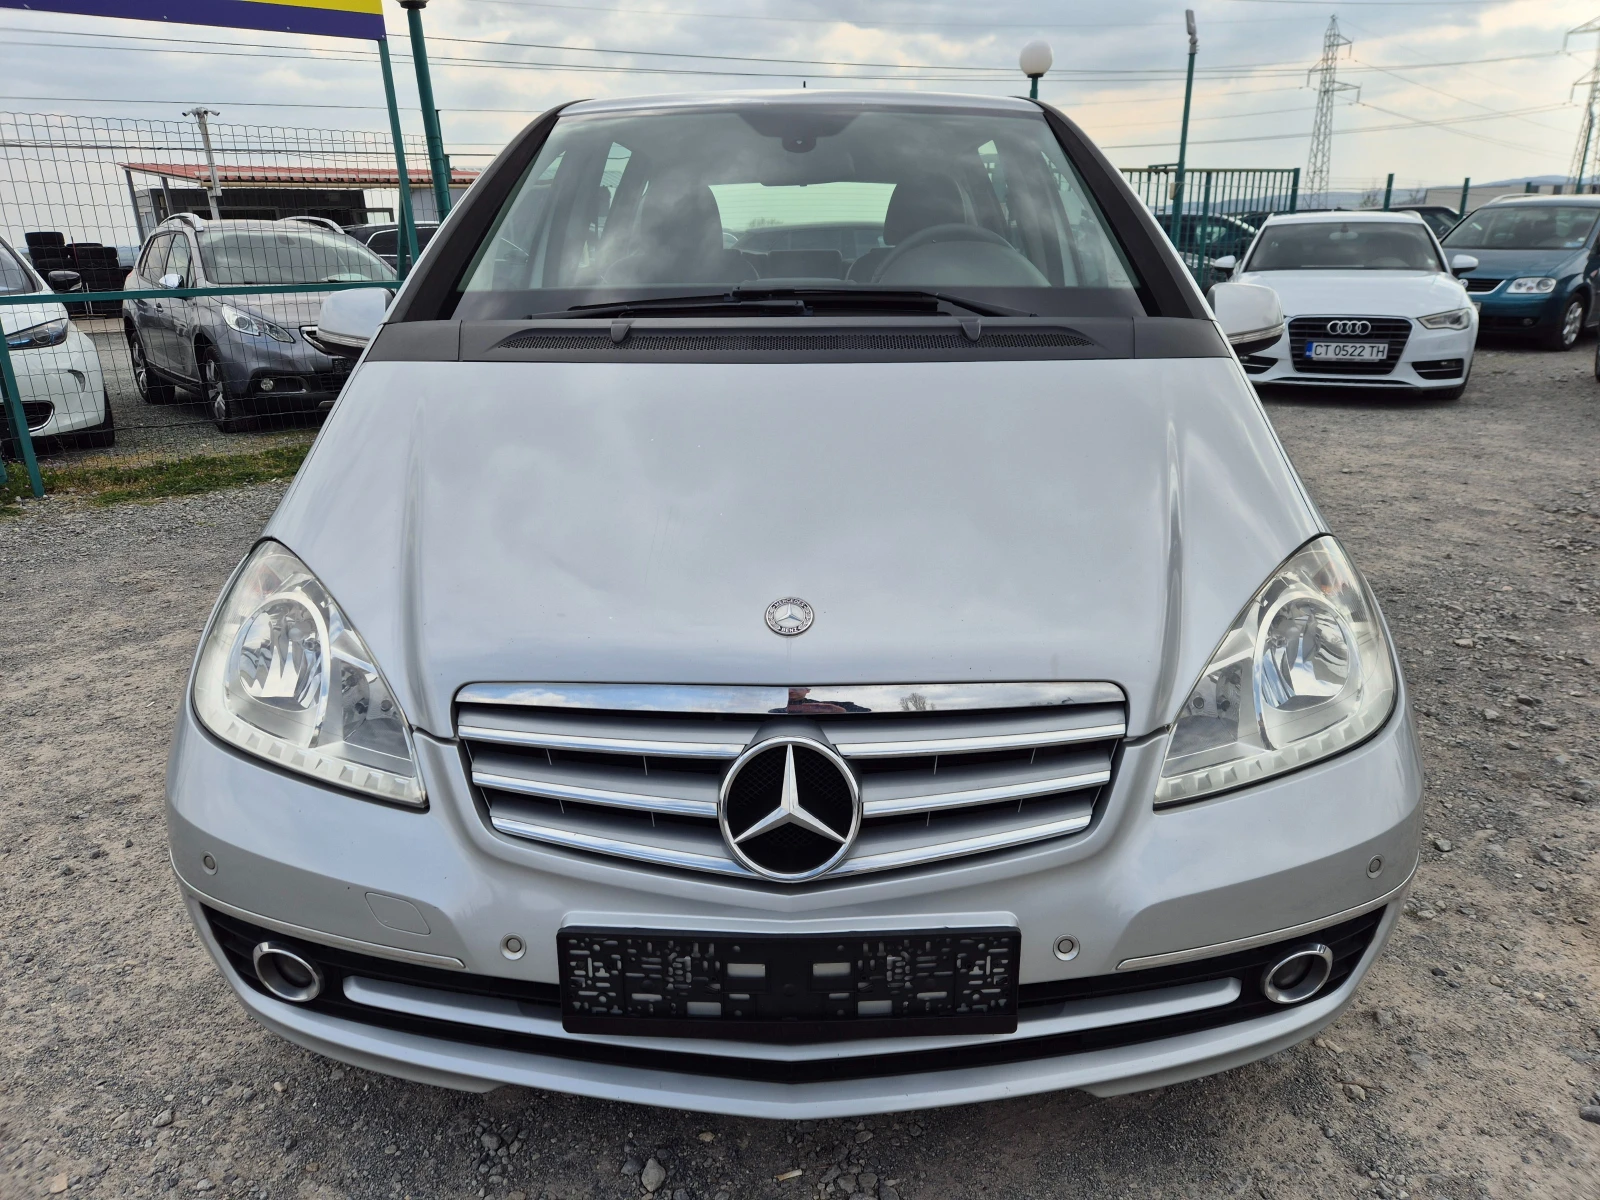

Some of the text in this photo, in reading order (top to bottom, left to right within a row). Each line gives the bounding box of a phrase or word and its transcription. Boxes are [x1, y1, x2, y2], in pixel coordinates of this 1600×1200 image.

[1314, 344, 1332, 356] CT
[1333, 345, 1366, 357] 0522
[1368, 345, 1386, 357] TH
